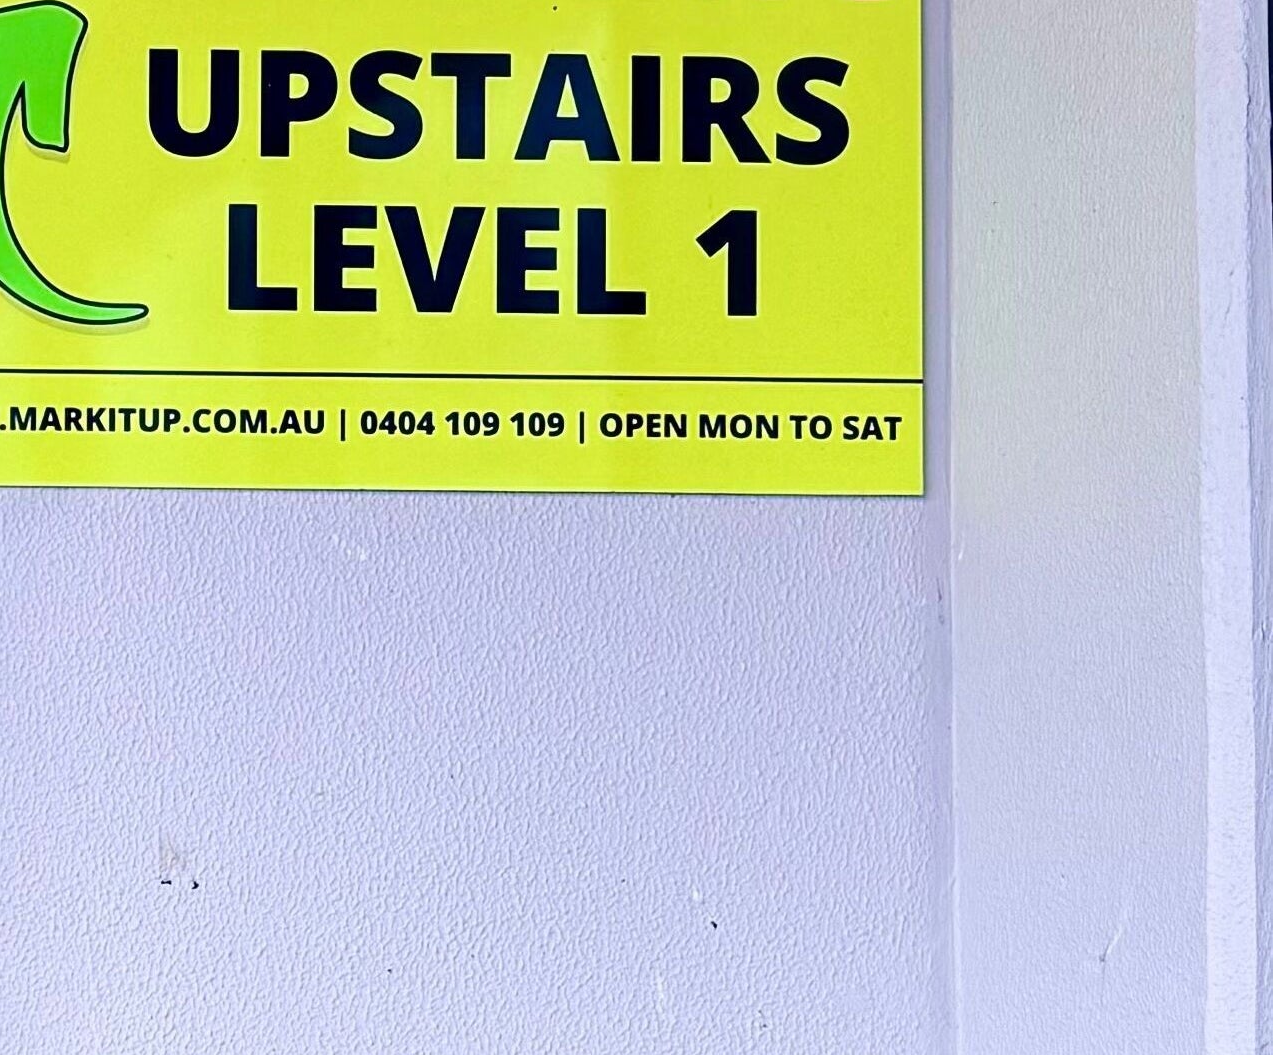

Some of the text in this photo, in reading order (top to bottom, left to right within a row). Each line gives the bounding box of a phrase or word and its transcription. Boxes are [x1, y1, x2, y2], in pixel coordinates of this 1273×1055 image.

[148, 48, 850, 166] UPSTAIRS
[227, 203, 758, 317] LEVEL 1
[360, 410, 436, 436] 0404
[444, 411, 500, 437] 109
[509, 411, 565, 437] 109
[599, 412, 688, 438] OPEN
[699, 413, 779, 439] MON
[789, 414, 833, 440] TO
[842, 415, 903, 441] SAT
